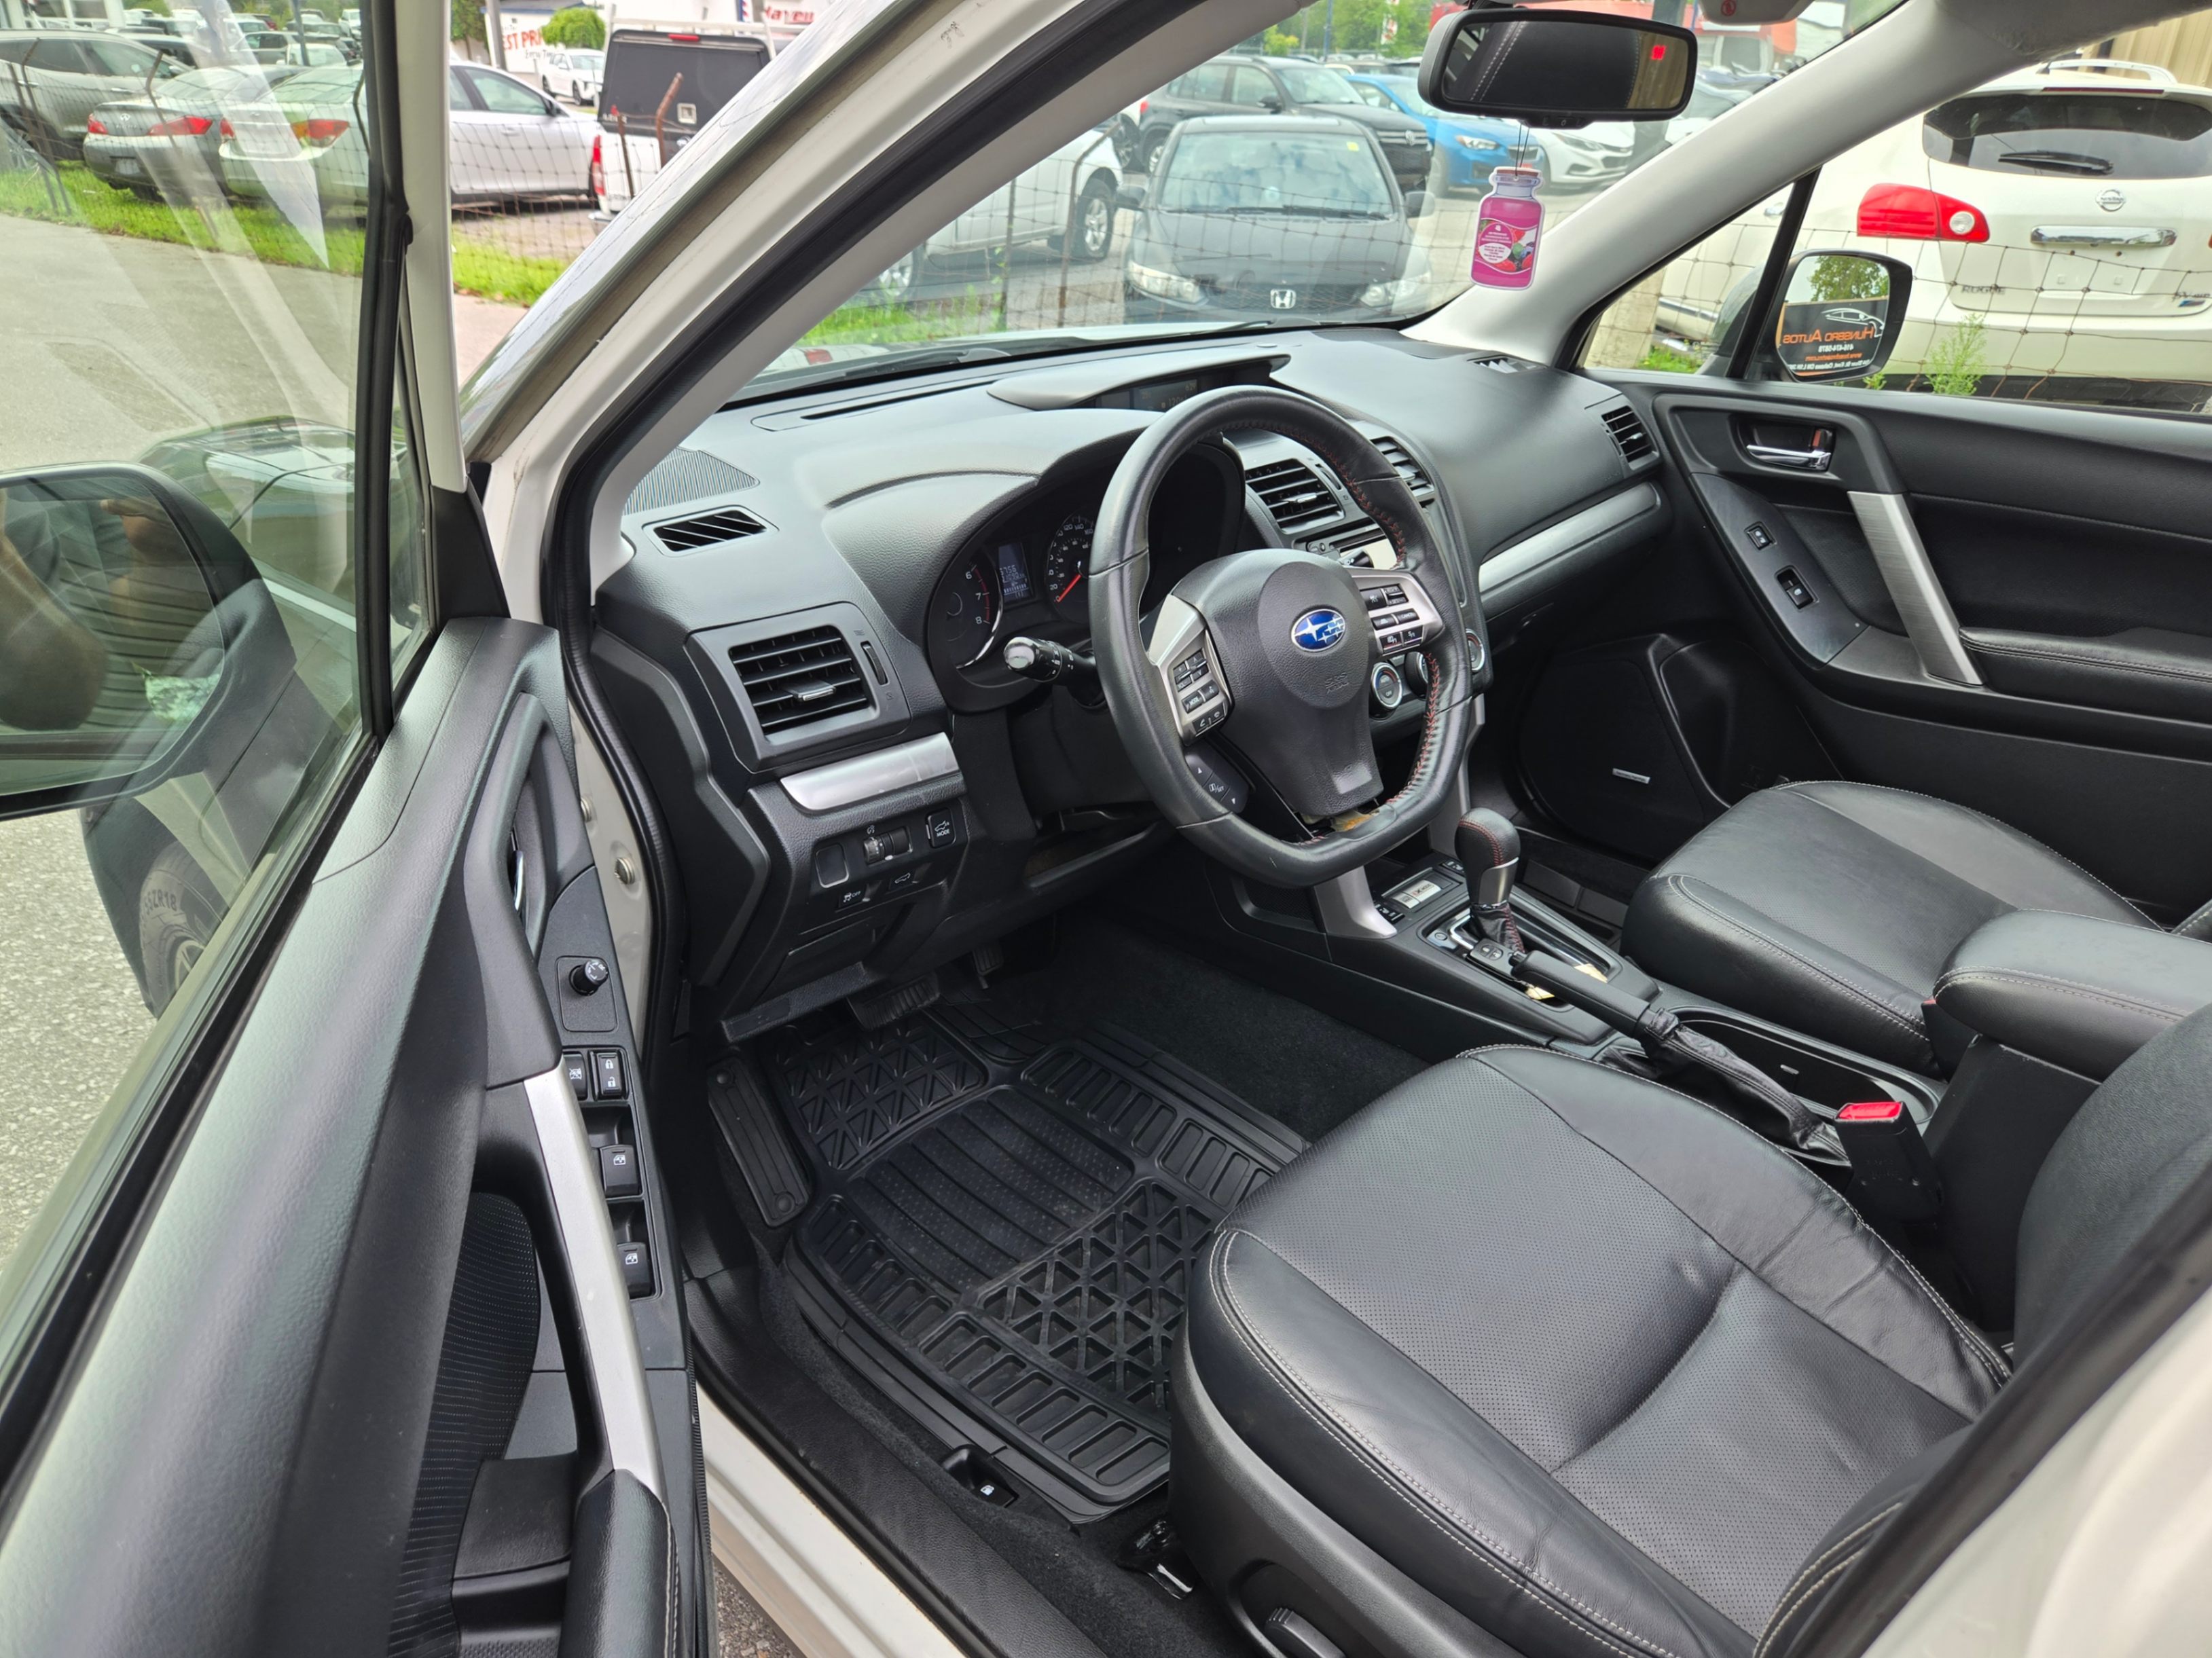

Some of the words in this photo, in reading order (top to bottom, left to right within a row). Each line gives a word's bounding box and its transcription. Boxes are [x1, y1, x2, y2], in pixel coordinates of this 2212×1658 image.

[965, 571, 973, 579] 6
[975, 592, 981, 600] 7
[975, 616, 983, 625] 8
[937, 828, 949, 837] MODE
